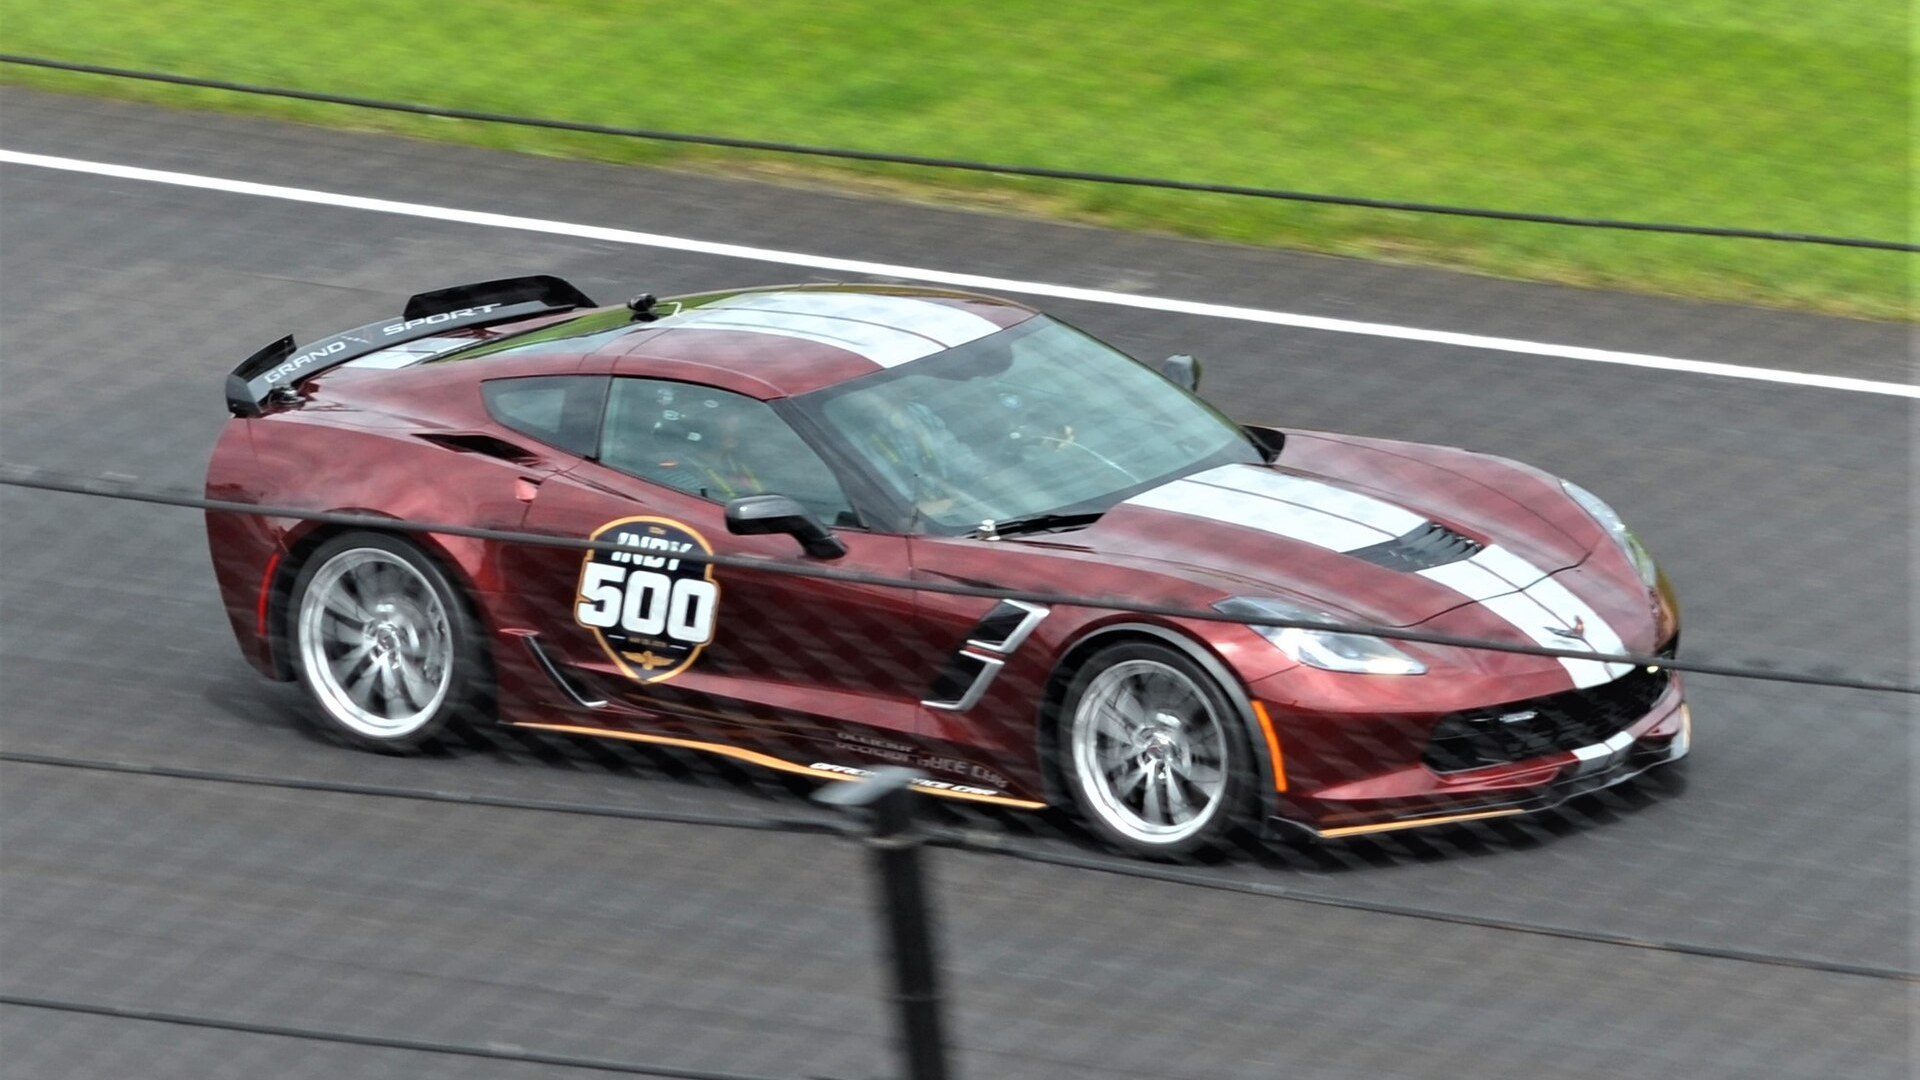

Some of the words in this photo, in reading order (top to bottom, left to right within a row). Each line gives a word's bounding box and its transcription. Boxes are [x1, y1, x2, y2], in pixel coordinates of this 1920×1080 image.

[264, 340, 346, 383] GRAND
[382, 302, 501, 336] SPORT
[611, 532, 693, 571] INDY
[577, 562, 717, 643] 500
